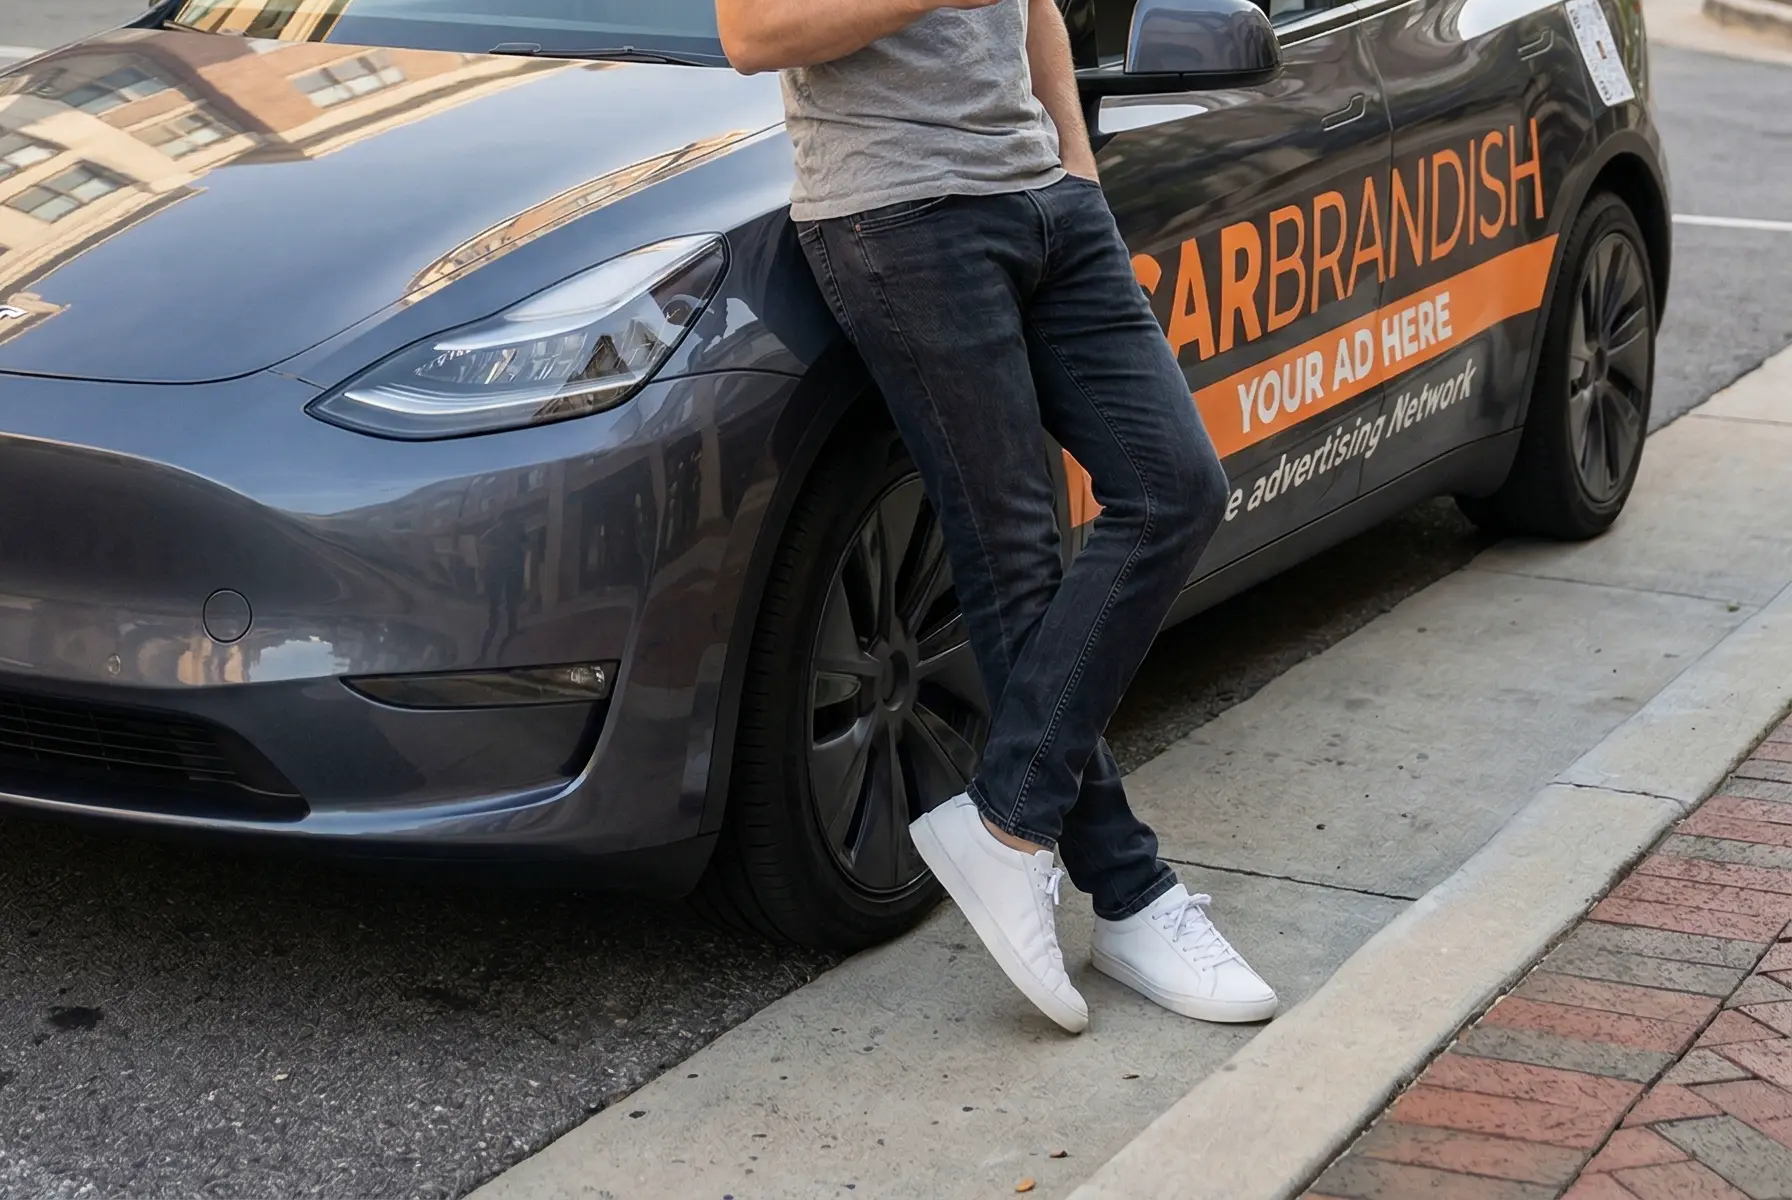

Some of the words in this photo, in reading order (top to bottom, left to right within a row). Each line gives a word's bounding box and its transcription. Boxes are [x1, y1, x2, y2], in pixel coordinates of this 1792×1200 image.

[1130, 118, 1544, 361] ARBRANDISH
[1237, 351, 1325, 434] YOUR
[1332, 328, 1375, 392] AD
[1381, 291, 1453, 367] HERE
[1246, 414, 1387, 511] advertising
[1386, 358, 1477, 439] Network
